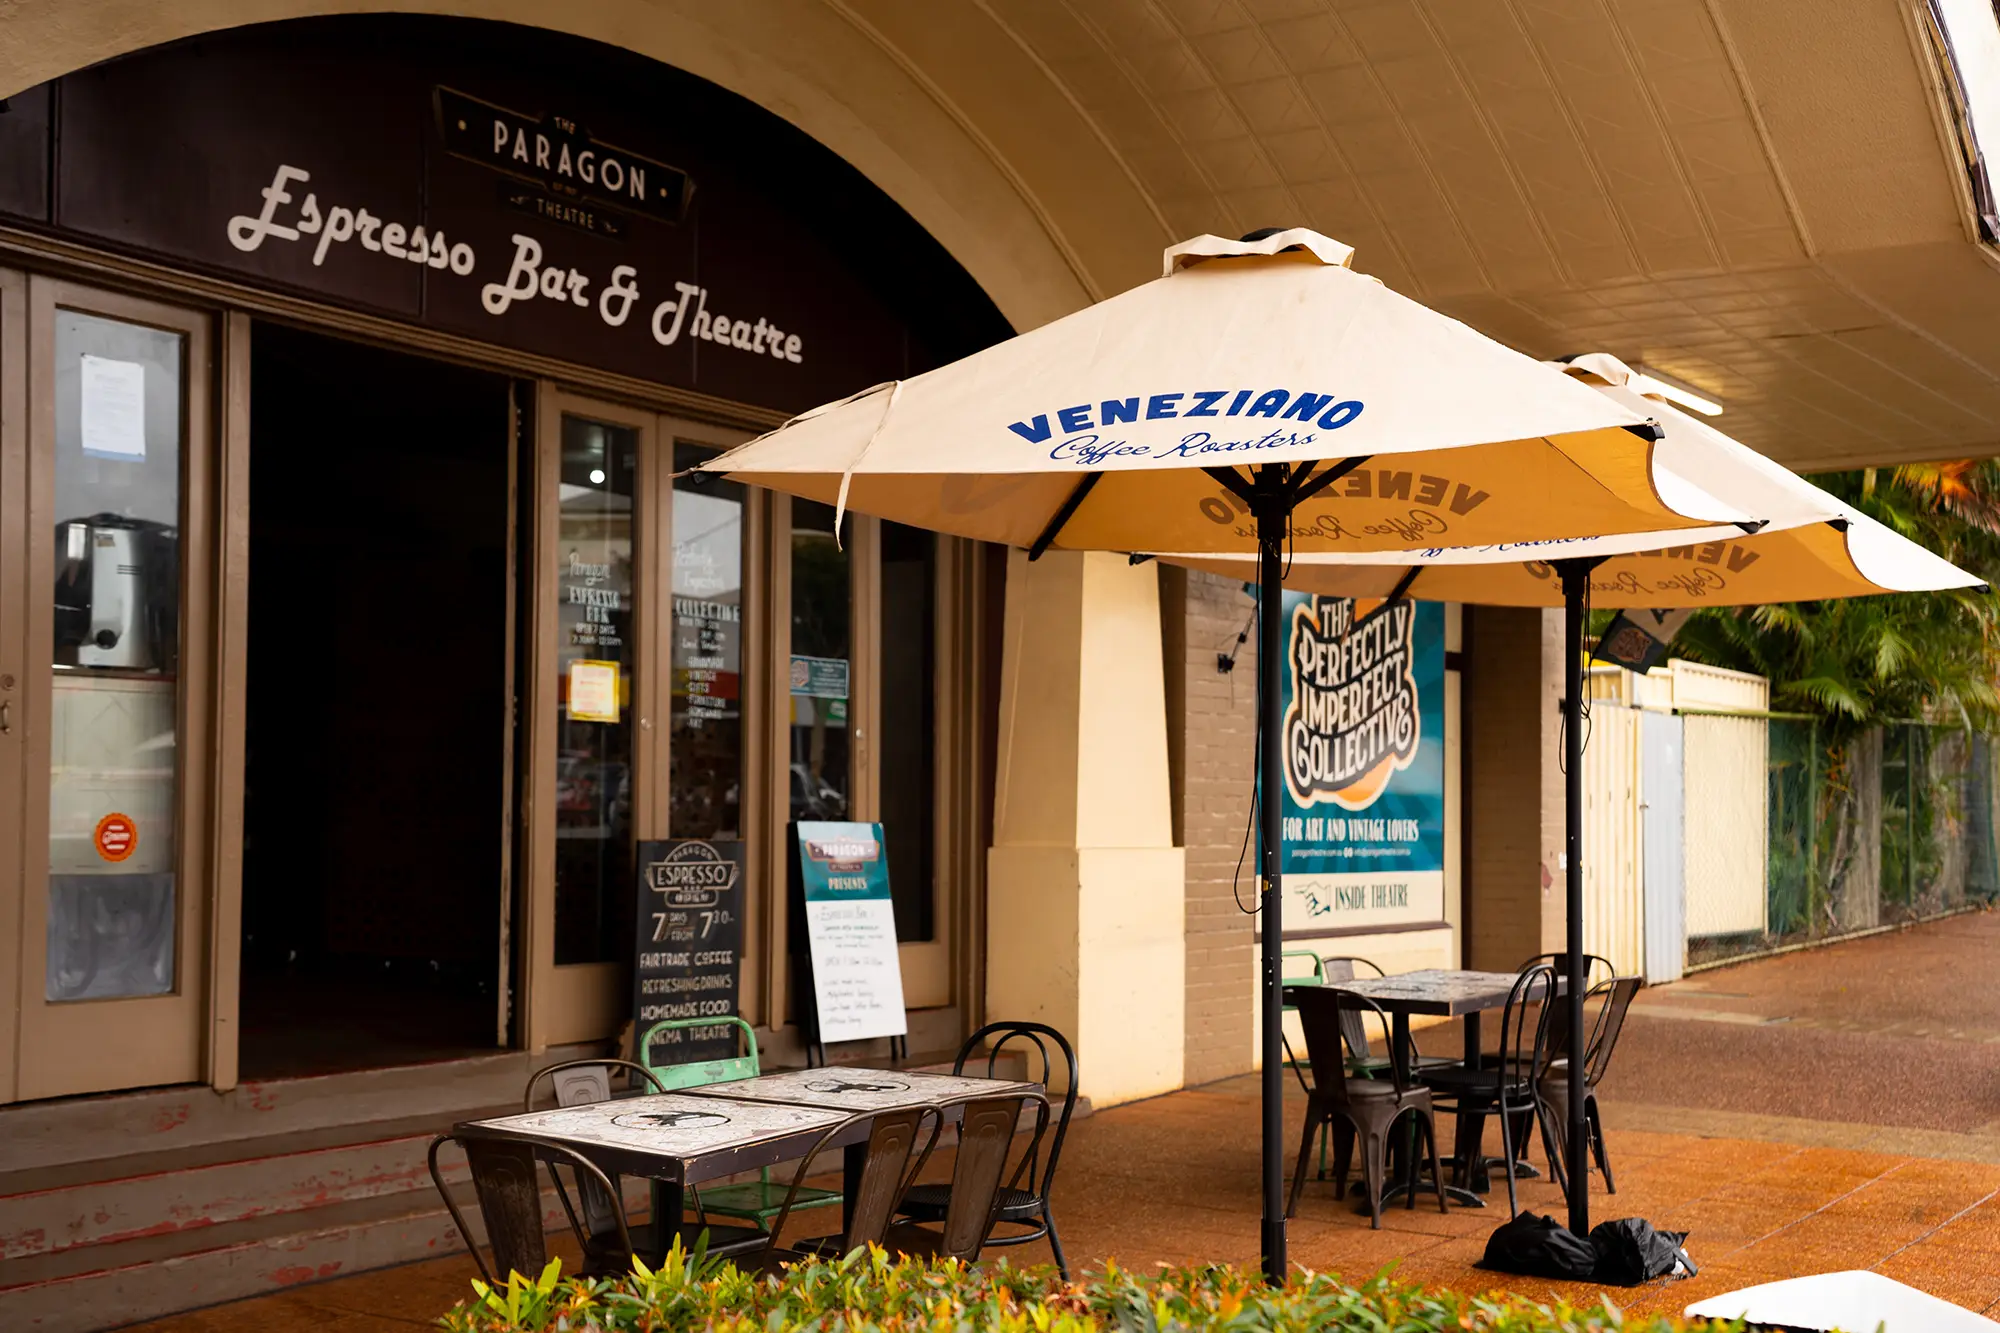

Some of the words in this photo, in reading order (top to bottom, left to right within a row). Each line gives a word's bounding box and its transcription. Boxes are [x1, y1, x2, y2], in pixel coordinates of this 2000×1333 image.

[554, 117, 576, 135] THE
[494, 119, 645, 201] PARAGON
[537, 198, 594, 230] THEATRE
[227, 164, 476, 277] Espresso
[482, 233, 590, 315] Bar
[600, 265, 639, 327] &
[651, 281, 803, 364] Theatre
[1006, 388, 1365, 444] VENEZIANO
[1049, 434, 1153, 465] Coffee
[1152, 429, 1319, 460] Roasters
[1321, 598, 1352, 638] THE
[1298, 605, 1408, 688] PERFECTLY
[1300, 651, 1406, 736] IMPERFECT
[1290, 689, 1413, 788] COLLECTIVE
[1282, 817, 1303, 841] FOR
[1305, 817, 1324, 842] ART
[1326, 818, 1346, 842] AND
[1348, 818, 1385, 842] VINTAGE
[1386, 819, 1420, 842] LOVERS
[656, 865, 728, 886] ESPRESSO
[1335, 884, 1366, 911] INSIDE
[1371, 884, 1409, 909] THEATRE
[652, 912, 666, 942] 7
[694, 950, 733, 966] COFFEE
[642, 977, 700, 995] REFRESHING
[700, 974, 733, 991] DRINKS
[641, 1001, 698, 1020] HOMEMADE
[700, 999, 731, 1016] FOOD
[689, 1024, 732, 1041] THEATRE
